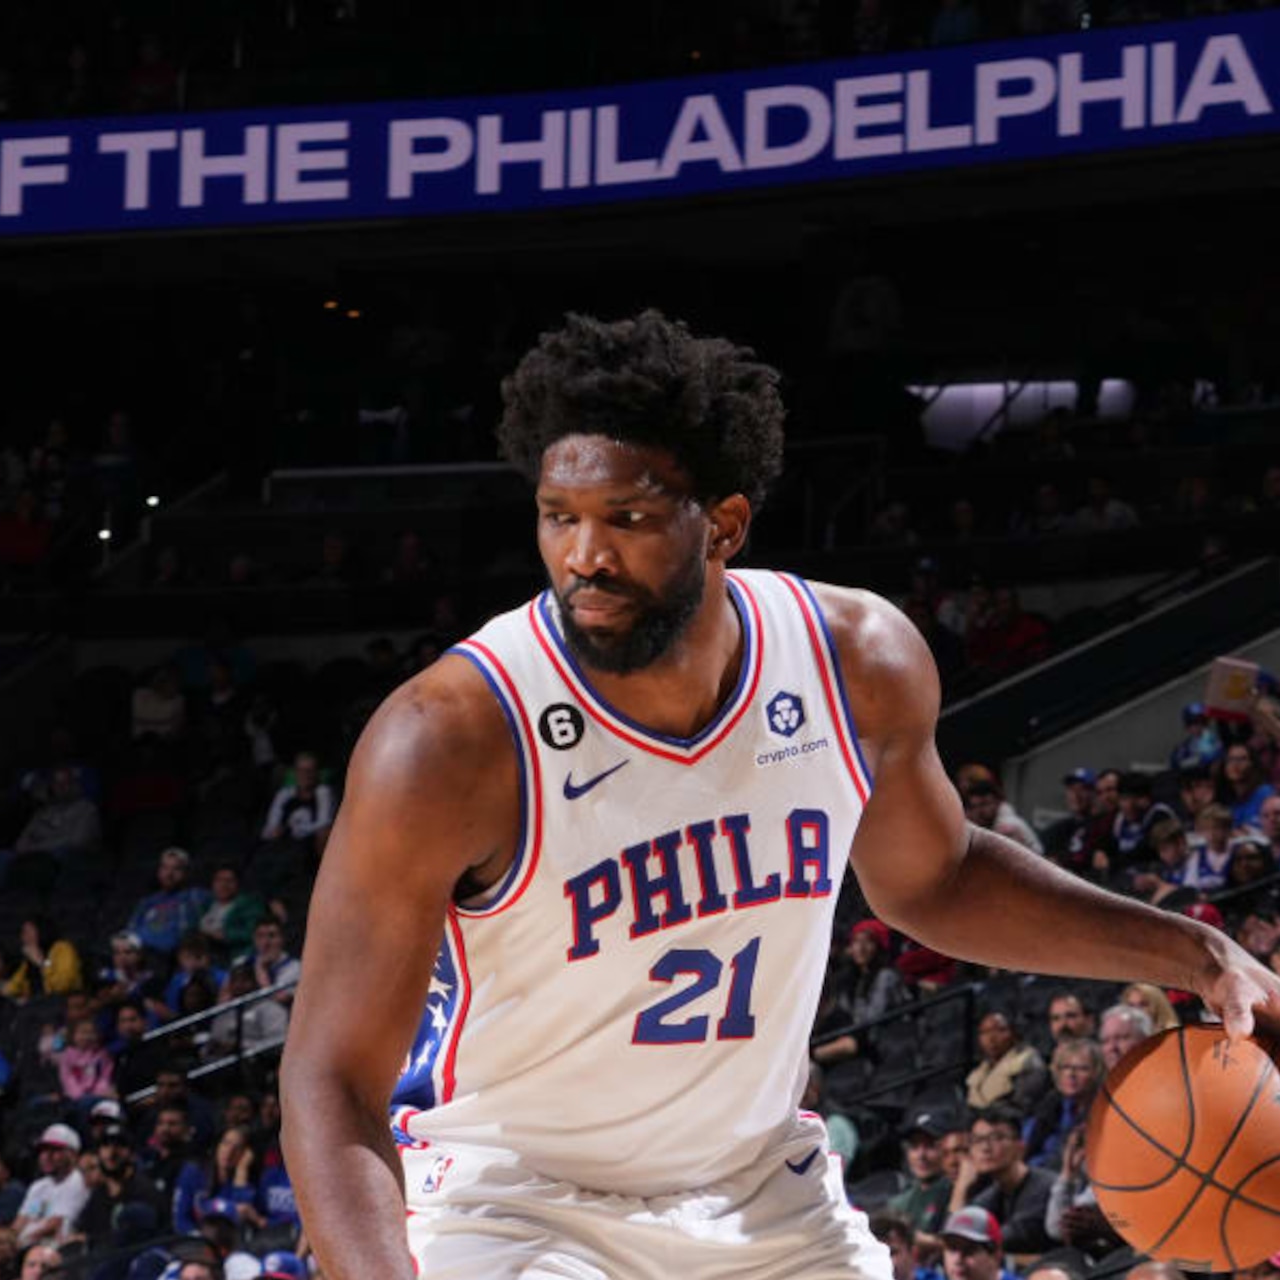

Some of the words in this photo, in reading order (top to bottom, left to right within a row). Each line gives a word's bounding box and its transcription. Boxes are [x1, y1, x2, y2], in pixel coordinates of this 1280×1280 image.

[98, 128, 350, 211] THE
[387, 33, 1273, 199] PHILADELPHIA
[547, 709, 577, 747] 6
[756, 736, 829, 766] crypto.com
[563, 808, 832, 963] PHILA
[631, 935, 761, 1045] 21
